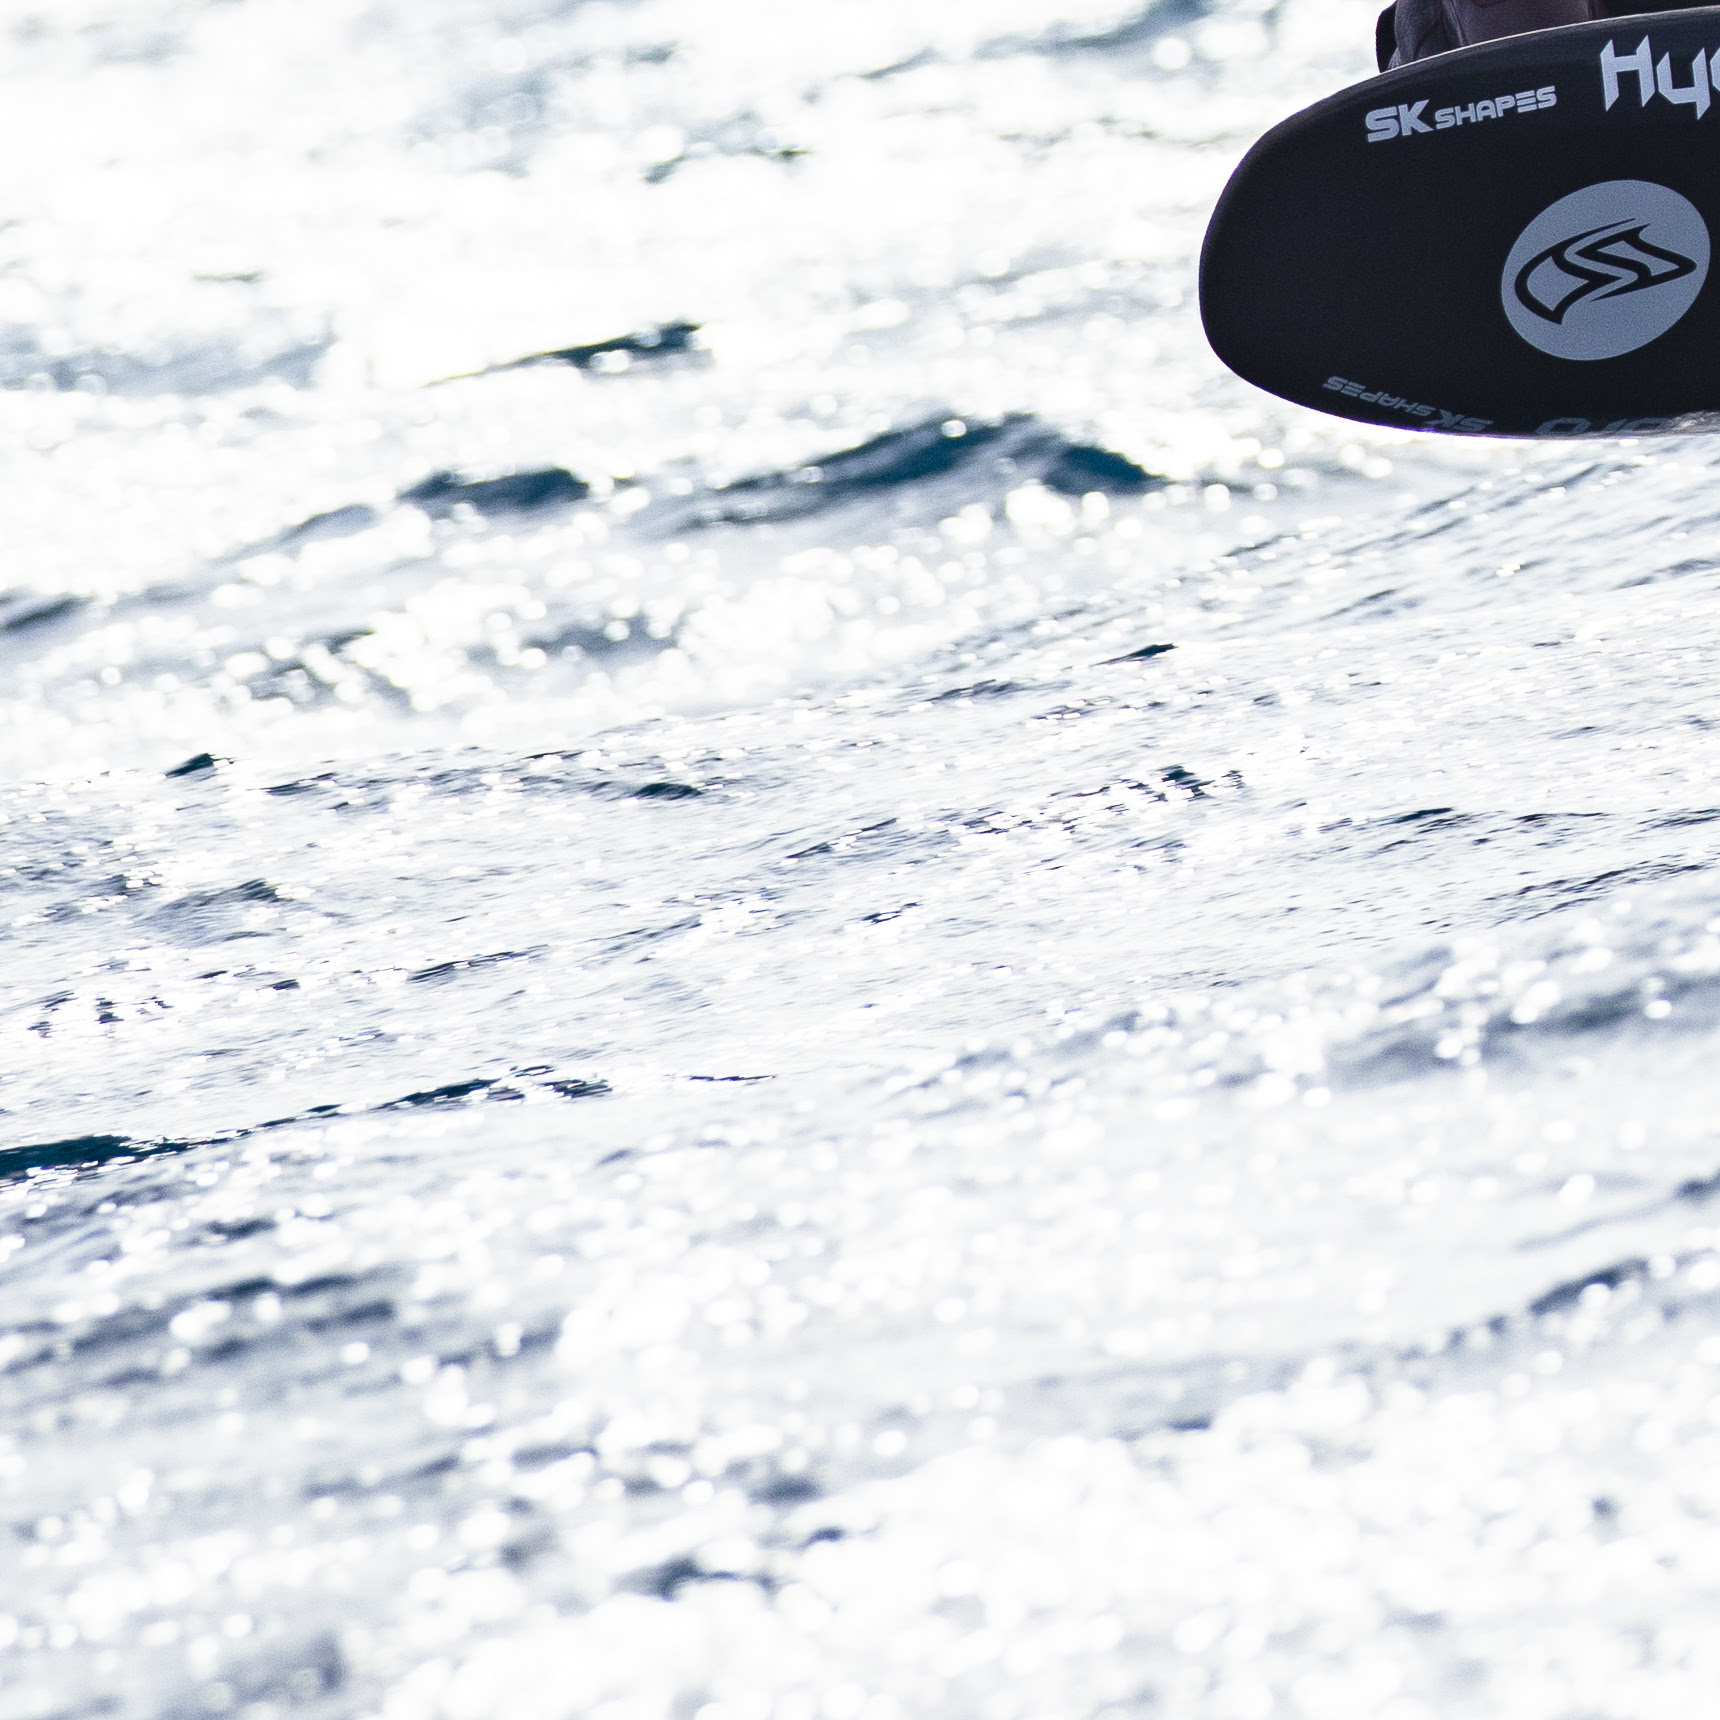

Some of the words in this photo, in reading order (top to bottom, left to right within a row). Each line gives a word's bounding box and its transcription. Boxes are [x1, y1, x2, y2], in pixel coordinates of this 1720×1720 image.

[1365, 99, 1434, 142] SK
[1435, 86, 1558, 129] SHAPES
[1322, 375, 1437, 417] SHAPES
